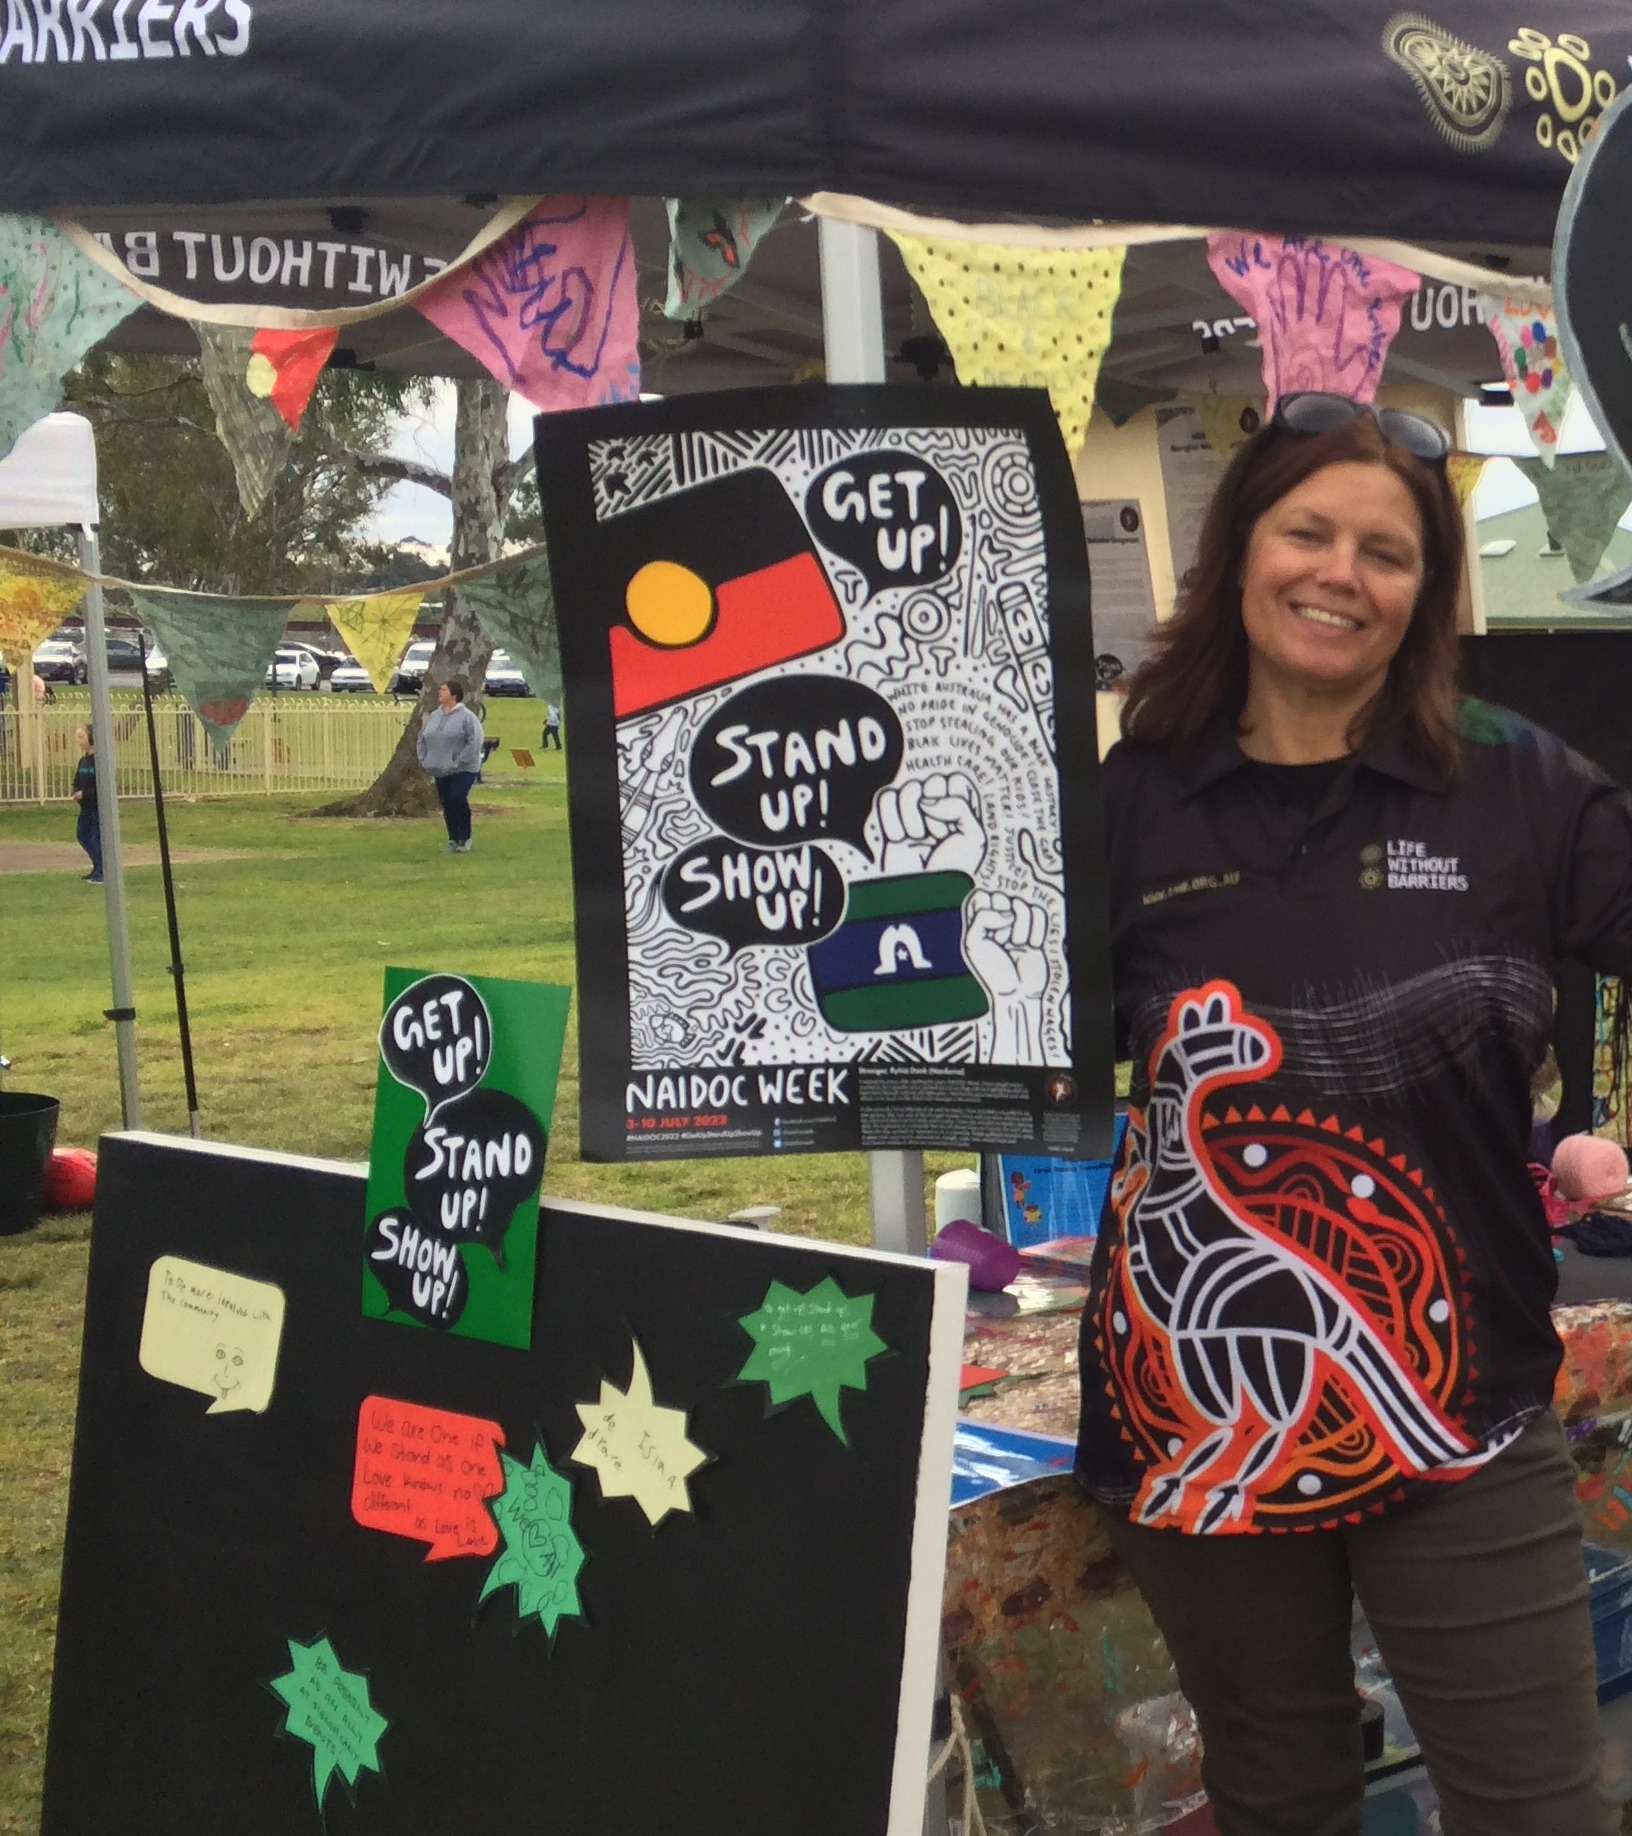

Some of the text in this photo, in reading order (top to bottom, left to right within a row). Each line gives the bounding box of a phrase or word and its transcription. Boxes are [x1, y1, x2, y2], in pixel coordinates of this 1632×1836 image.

[0, 0, 251, 63] ARRIERS
[821, 470, 926, 524] GET
[877, 504, 949, 574] UP!
[886, 682, 928, 701] WHITE
[935, 681, 991, 705] AUSTRALIA
[898, 701, 915, 716] NO
[921, 699, 955, 711] PRIDE
[962, 704, 978, 715] IN
[710, 716, 887, 788] STAND
[906, 716, 935, 732] STOP
[940, 716, 995, 748] STEALING
[907, 737, 939, 751] BLAK
[949, 736, 981, 756] LIVES
[906, 755, 951, 772] HEALTH
[759, 778, 829, 834] UP!
[1387, 840, 1426, 857] LIFE
[1387, 857, 1458, 873] WITHOUT
[679, 845, 811, 913] SHOW
[755, 867, 822, 931] UP!
[997, 875, 1028, 891] STOP
[1032, 886, 1056, 907] THE
[1387, 873, 1469, 891] BARRIERS
[393, 990, 464, 1052] GET
[433, 1015, 482, 1085] UP!
[625, 1073, 748, 1113] NAIDOC
[758, 1069, 850, 1104] WEEK
[660, 1116, 690, 1128] JULY
[414, 1126, 533, 1182] STAND
[440, 1186, 488, 1233] UP!
[371, 1217, 456, 1283] SHOW
[412, 1270, 459, 1319] UP!
